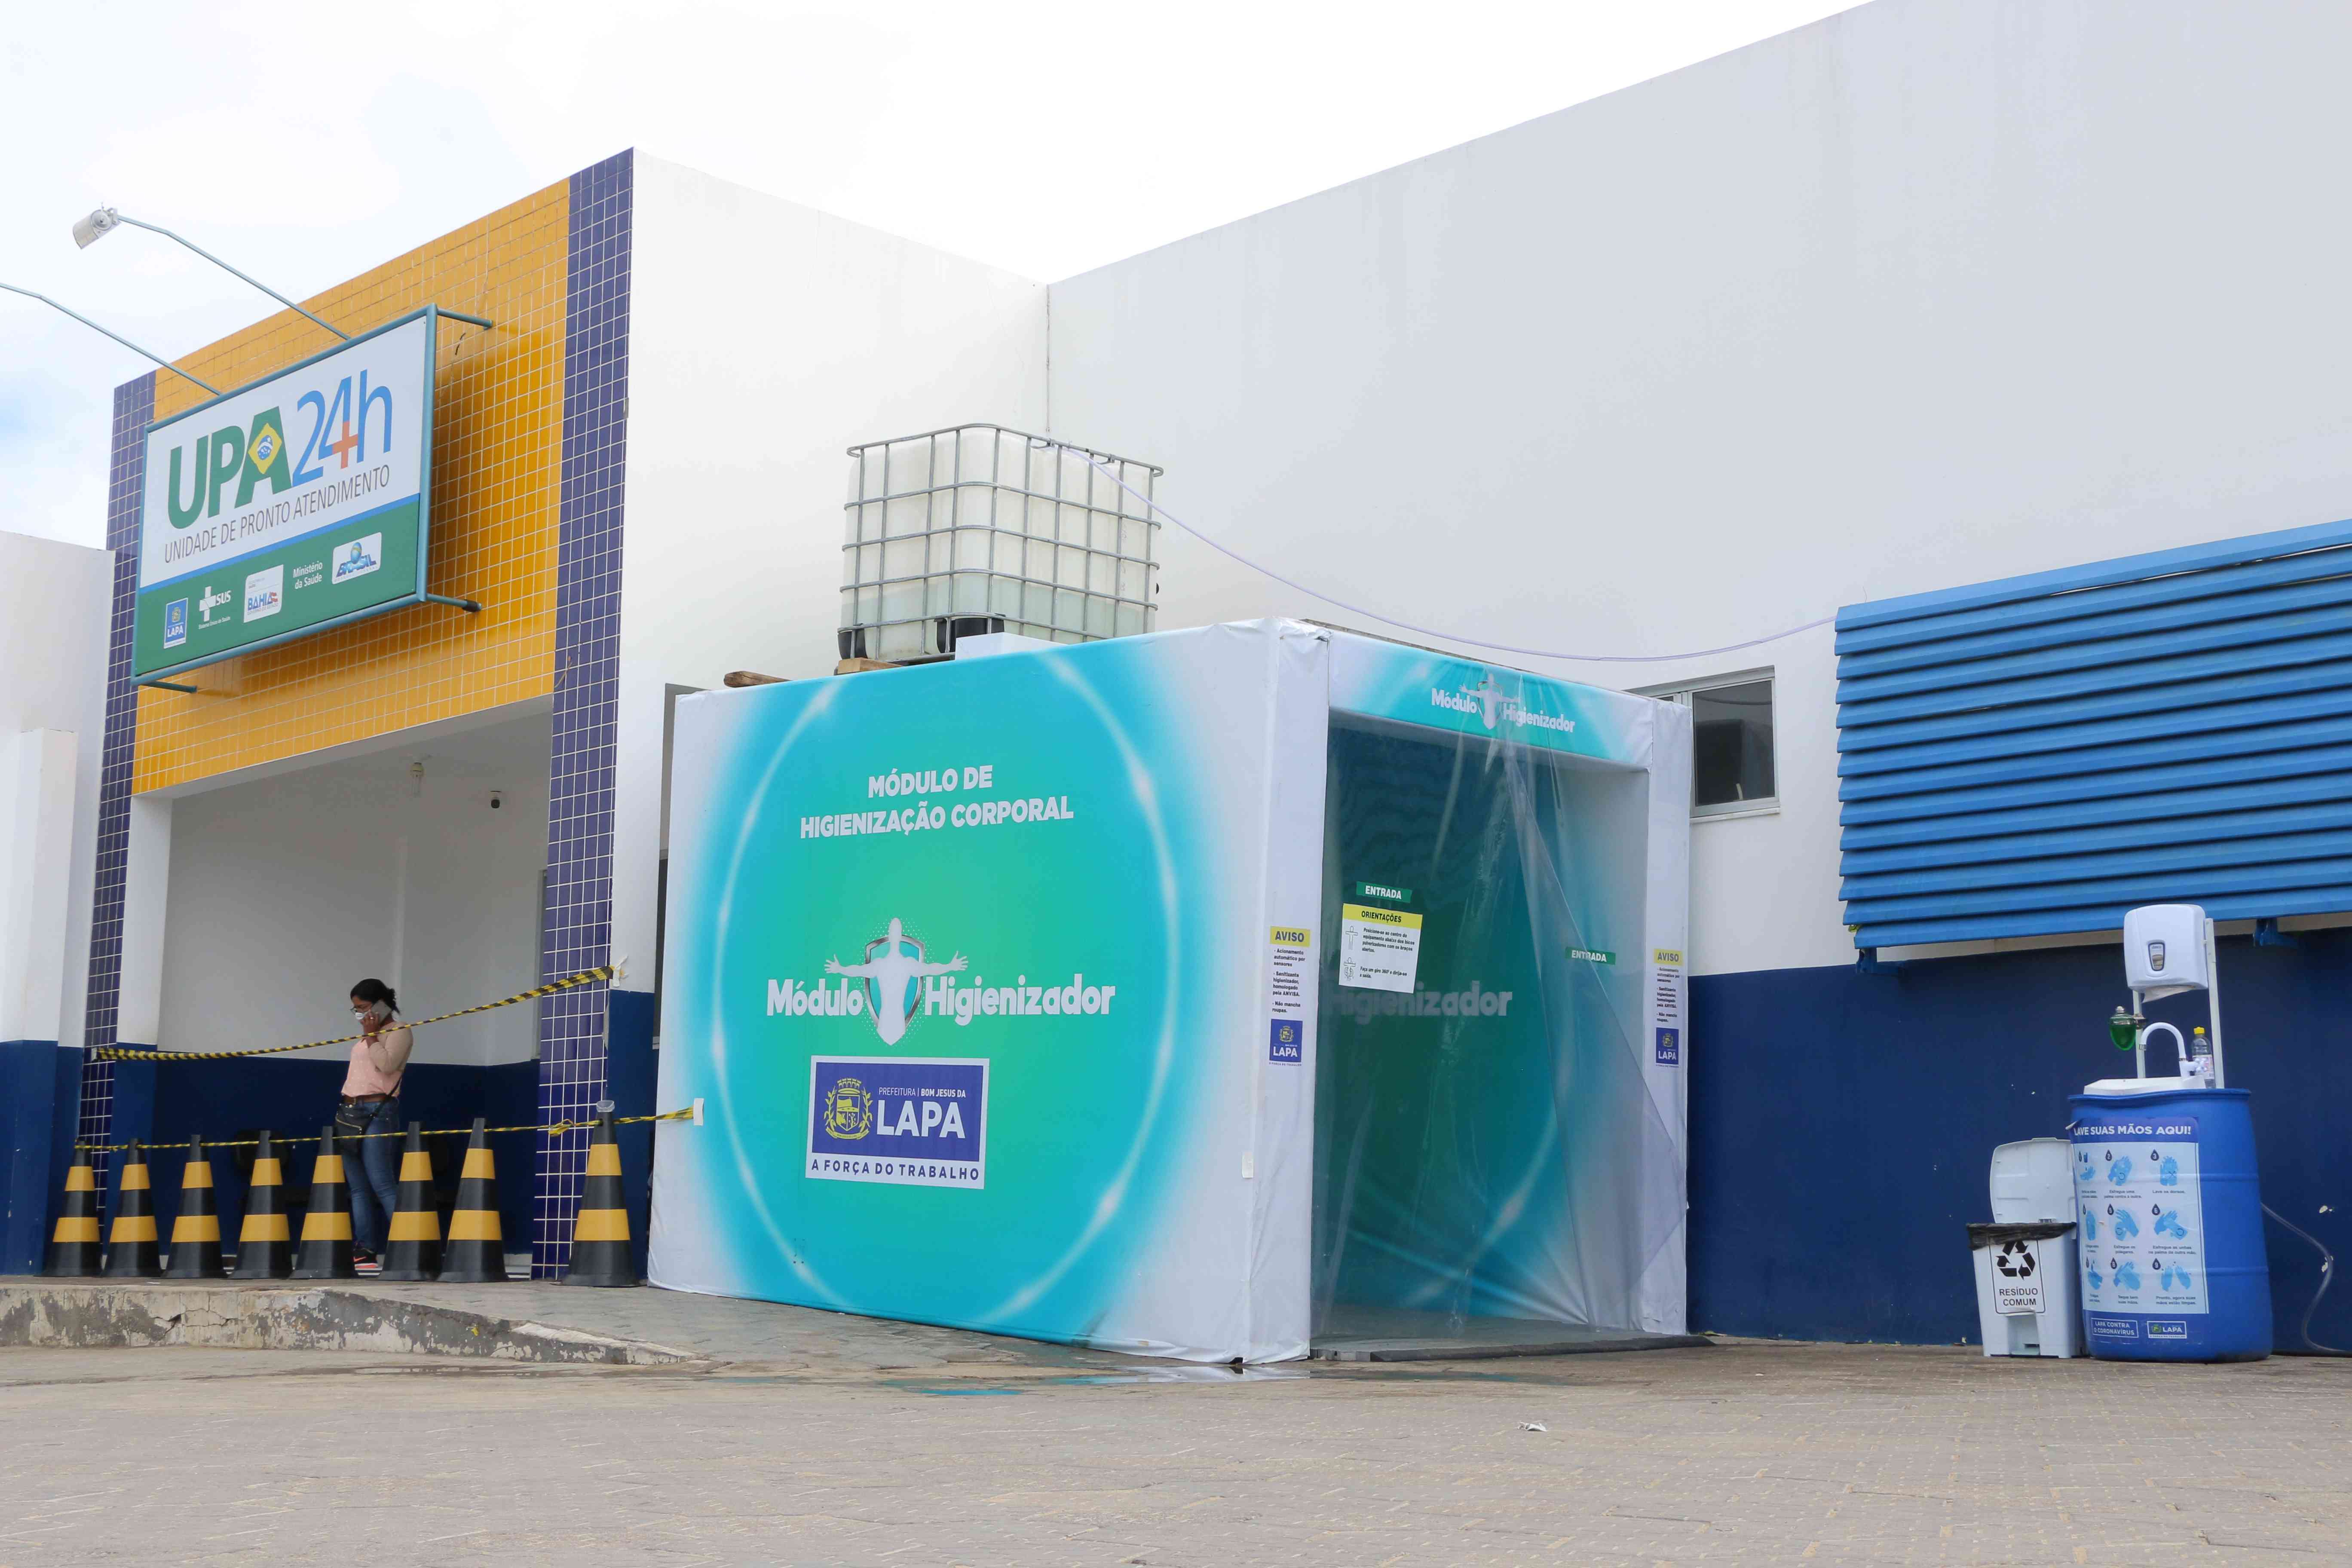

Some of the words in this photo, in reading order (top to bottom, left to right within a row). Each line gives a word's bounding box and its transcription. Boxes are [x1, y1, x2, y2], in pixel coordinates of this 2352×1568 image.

[168, 406, 292, 529] UPA
[292, 369, 392, 487] 24h
[165, 527, 217, 563] UNIDADE
[221, 520, 236, 545] DE
[240, 501, 290, 537] PRONTO
[293, 464, 389, 520] ATENDIMENTO
[293, 560, 322, 578] Ministério
[295, 579, 303, 589] da
[304, 573, 322, 587] Saúde
[216, 590, 231, 605] SUS
[248, 591, 273, 611] BAHIA
[167, 625, 184, 637] LAPA
[1431, 688, 1477, 713] Módulo
[1504, 703, 1575, 732] Higienizador
[868, 768, 959, 798] MÓDULO
[963, 765, 993, 790] DE
[800, 800, 946, 839] HIGIENIZAÇÃO
[951, 796, 1074, 828] CORPORAL
[1365, 885, 1402, 899] ENTRADA
[1361, 911, 1402, 923] ORIENTAÇÕES
[1275, 931, 1305, 942] AVISO
[1571, 950, 1607, 962] ENTRADA
[1657, 952, 1679, 962] AVISO
[767, 978, 864, 1016] Módulo
[925, 974, 1116, 1026] Higienizador
[1273, 1046, 1298, 1057] LAPA
[1658, 1050, 1676, 1060] LAPA
[879, 1087, 916, 1096] PREFEITURA
[921, 1088, 935, 1096] BOM
[936, 1088, 956, 1097] JESUS
[957, 1089, 966, 1098] DA
[876, 1099, 966, 1139] LAPA
[2073, 1127, 2089, 1136] LAVE
[2091, 1126, 2115, 1135] SUAS
[2118, 1123, 2153, 1135] MÃOS
[2156, 1126, 2191, 1135] AQUI!
[812, 1159, 819, 1170] A
[824, 1160, 870, 1175] FORÇA
[875, 1163, 894, 1175] DO
[899, 1164, 979, 1180] TRABALHO
[1999, 1286, 2038, 1296] RESÍDUO
